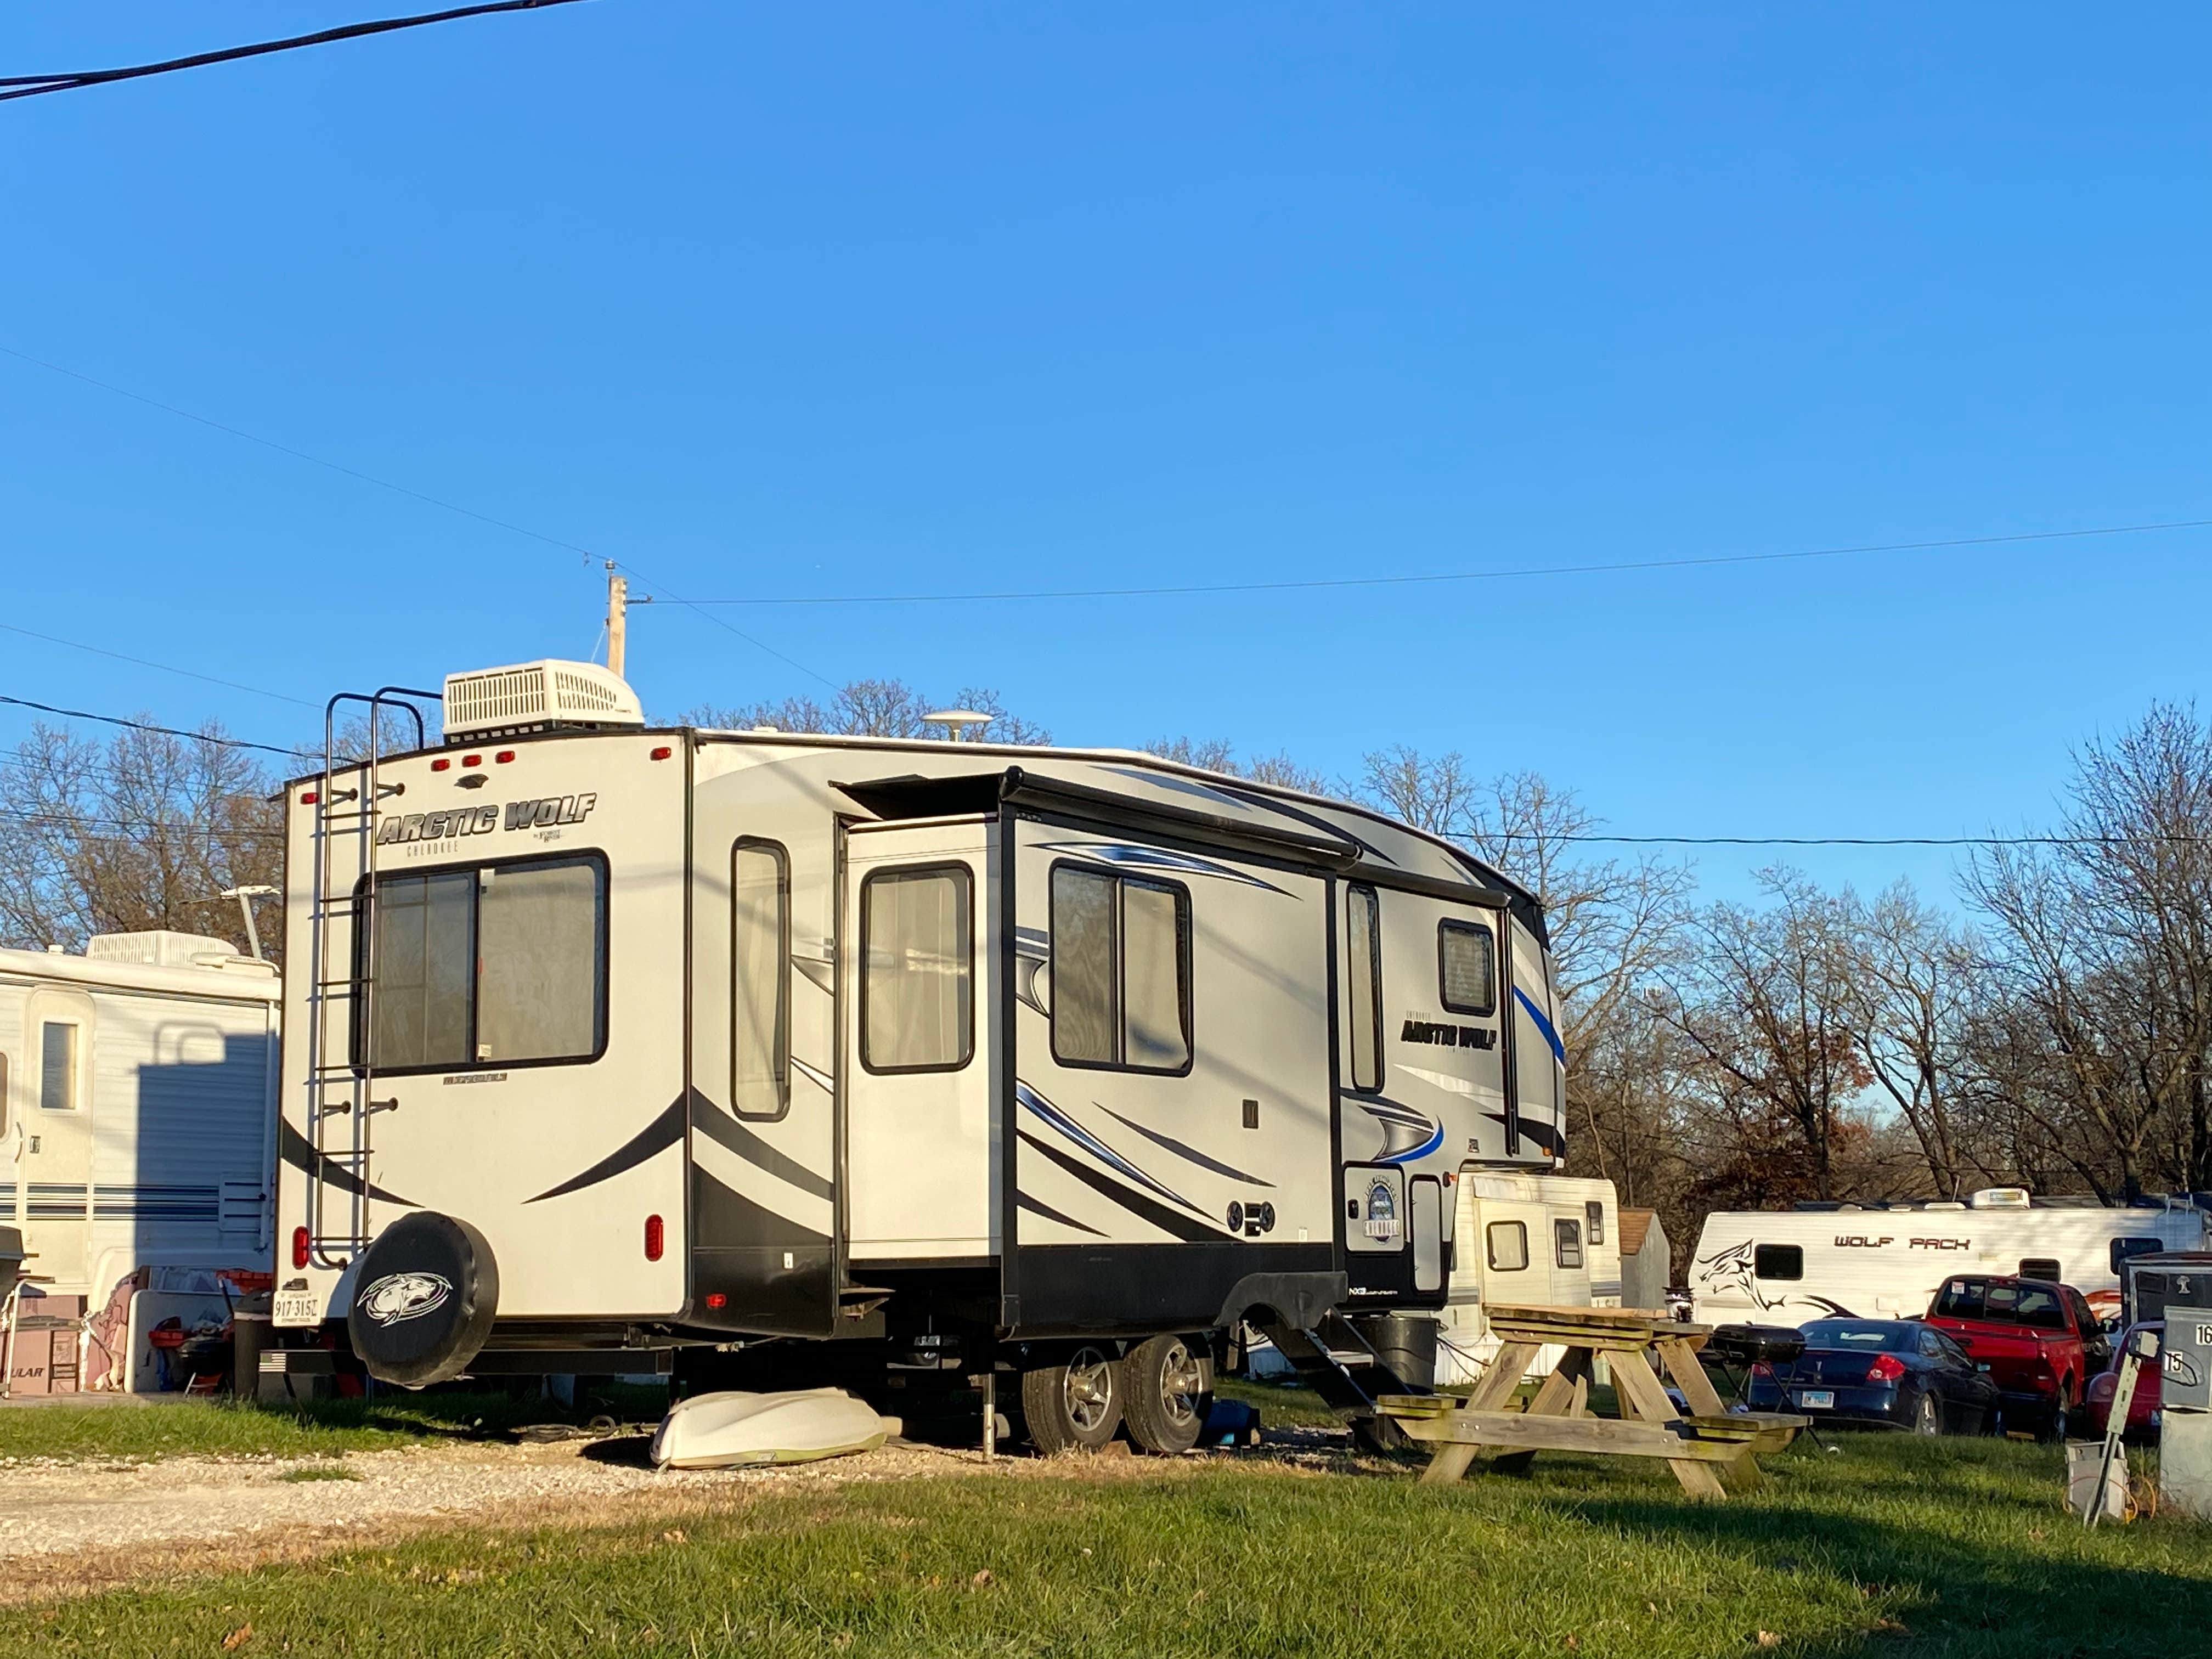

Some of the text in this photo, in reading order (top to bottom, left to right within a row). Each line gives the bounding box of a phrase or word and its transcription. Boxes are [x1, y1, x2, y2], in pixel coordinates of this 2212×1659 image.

[376, 793, 597, 845] ARCTIC WOLF
[407, 840, 458, 857] CHEROKEE
[1401, 1020, 1497, 1051] ARCTIC WOLF
[1834, 1236, 1971, 1250] WOLF PACK
[2198, 1325, 2212, 1344] 16
[2168, 1353, 2181, 1371] 15
